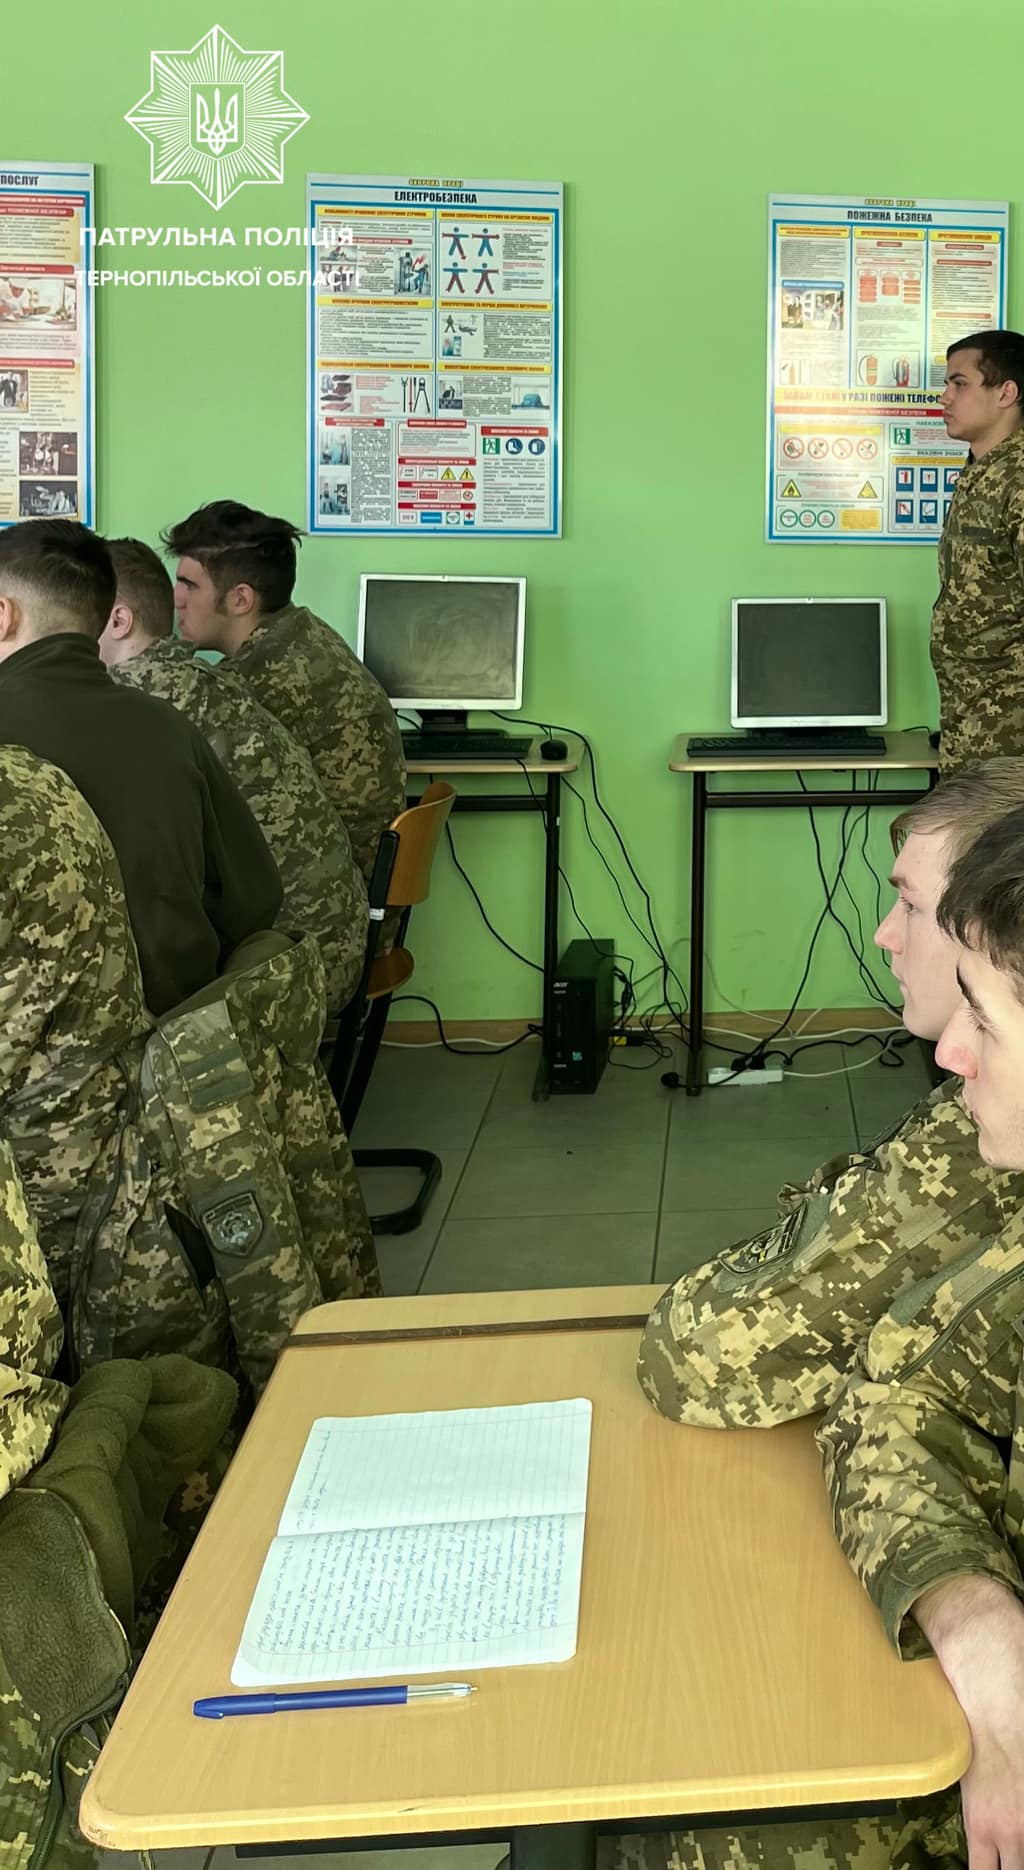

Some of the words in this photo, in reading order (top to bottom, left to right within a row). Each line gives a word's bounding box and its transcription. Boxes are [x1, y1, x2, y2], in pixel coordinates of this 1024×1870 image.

[394, 190, 477, 204] ЕЛЕКТРОБЕЗПЕКА
[847, 210, 892, 222] ПОЖЕЖНА
[895, 211, 933, 223] БЕЗПЕКА
